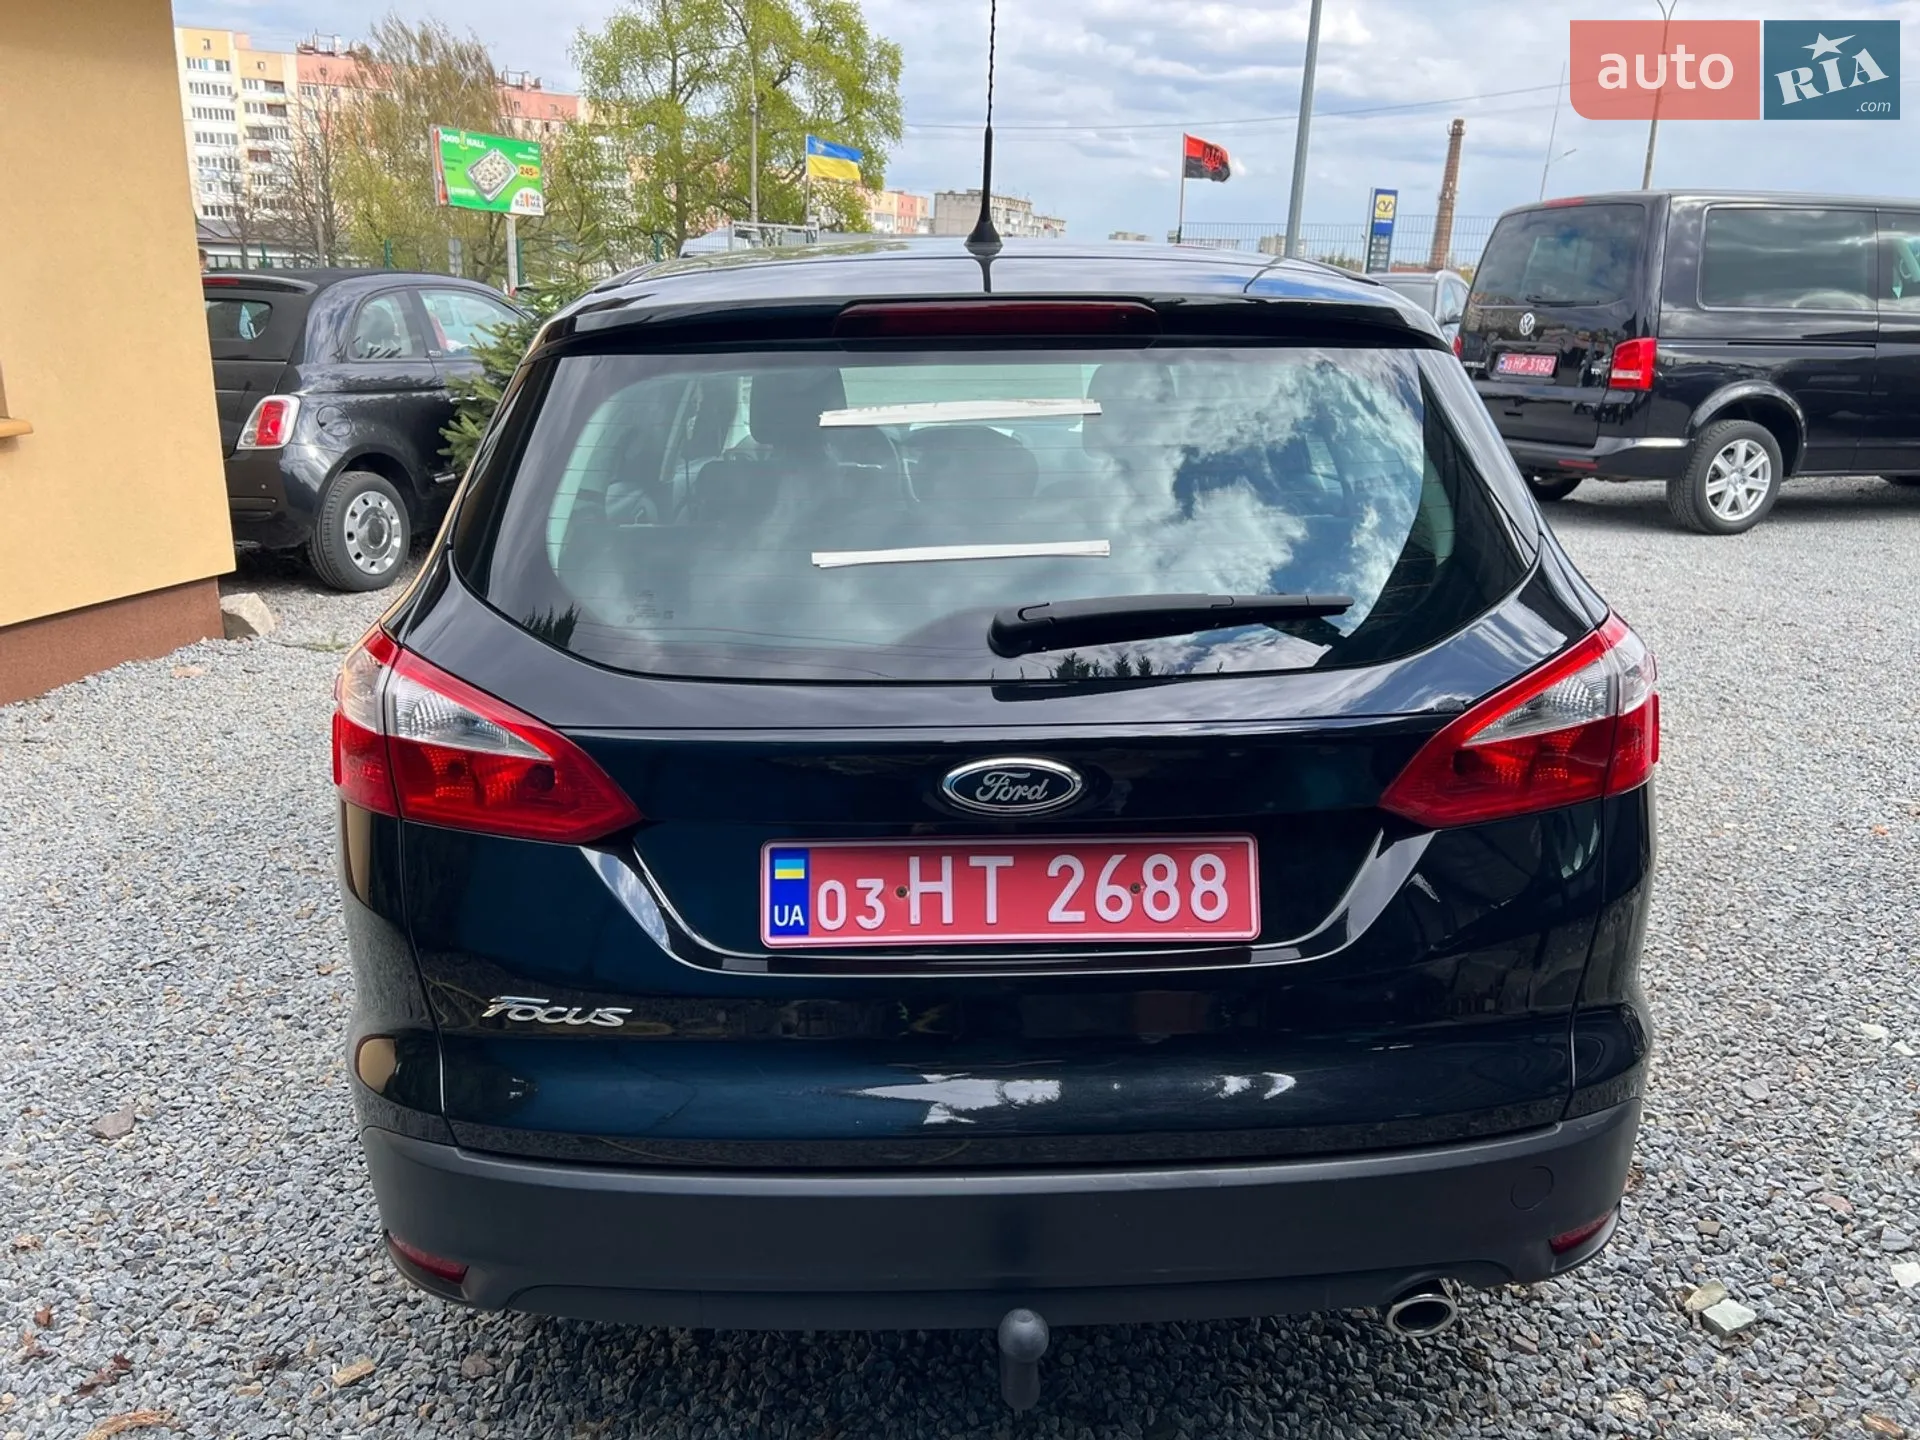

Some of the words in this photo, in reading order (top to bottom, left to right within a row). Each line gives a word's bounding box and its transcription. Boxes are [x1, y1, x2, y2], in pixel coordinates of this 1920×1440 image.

[975, 771, 1049, 801] Ford
[817, 879, 885, 931] 03
[908, 855, 1015, 925] HT
[1047, 853, 1228, 924] 2688
[774, 904, 805, 927] UA
